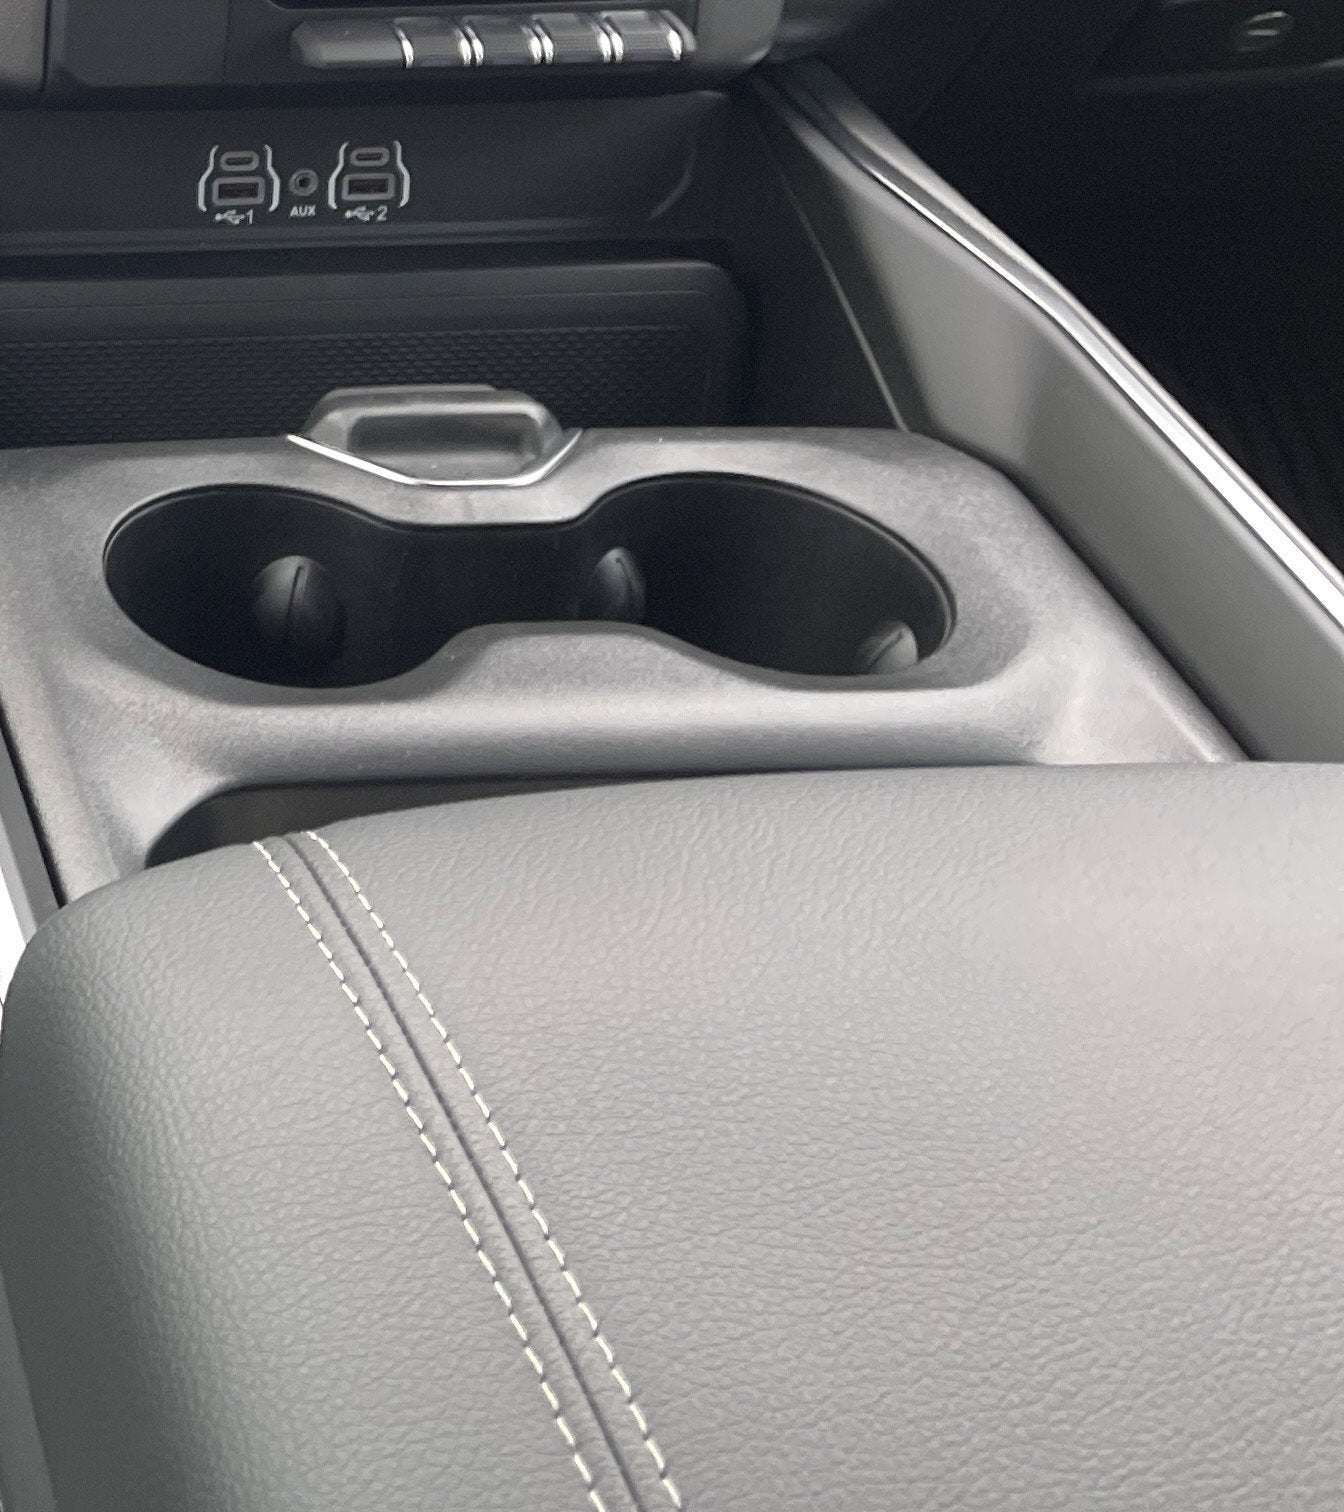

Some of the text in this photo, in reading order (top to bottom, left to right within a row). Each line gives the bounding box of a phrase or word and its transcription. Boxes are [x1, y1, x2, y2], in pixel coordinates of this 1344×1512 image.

[246, 208, 254, 225] 1
[288, 204, 316, 218] AUX
[376, 204, 389, 222] 2
